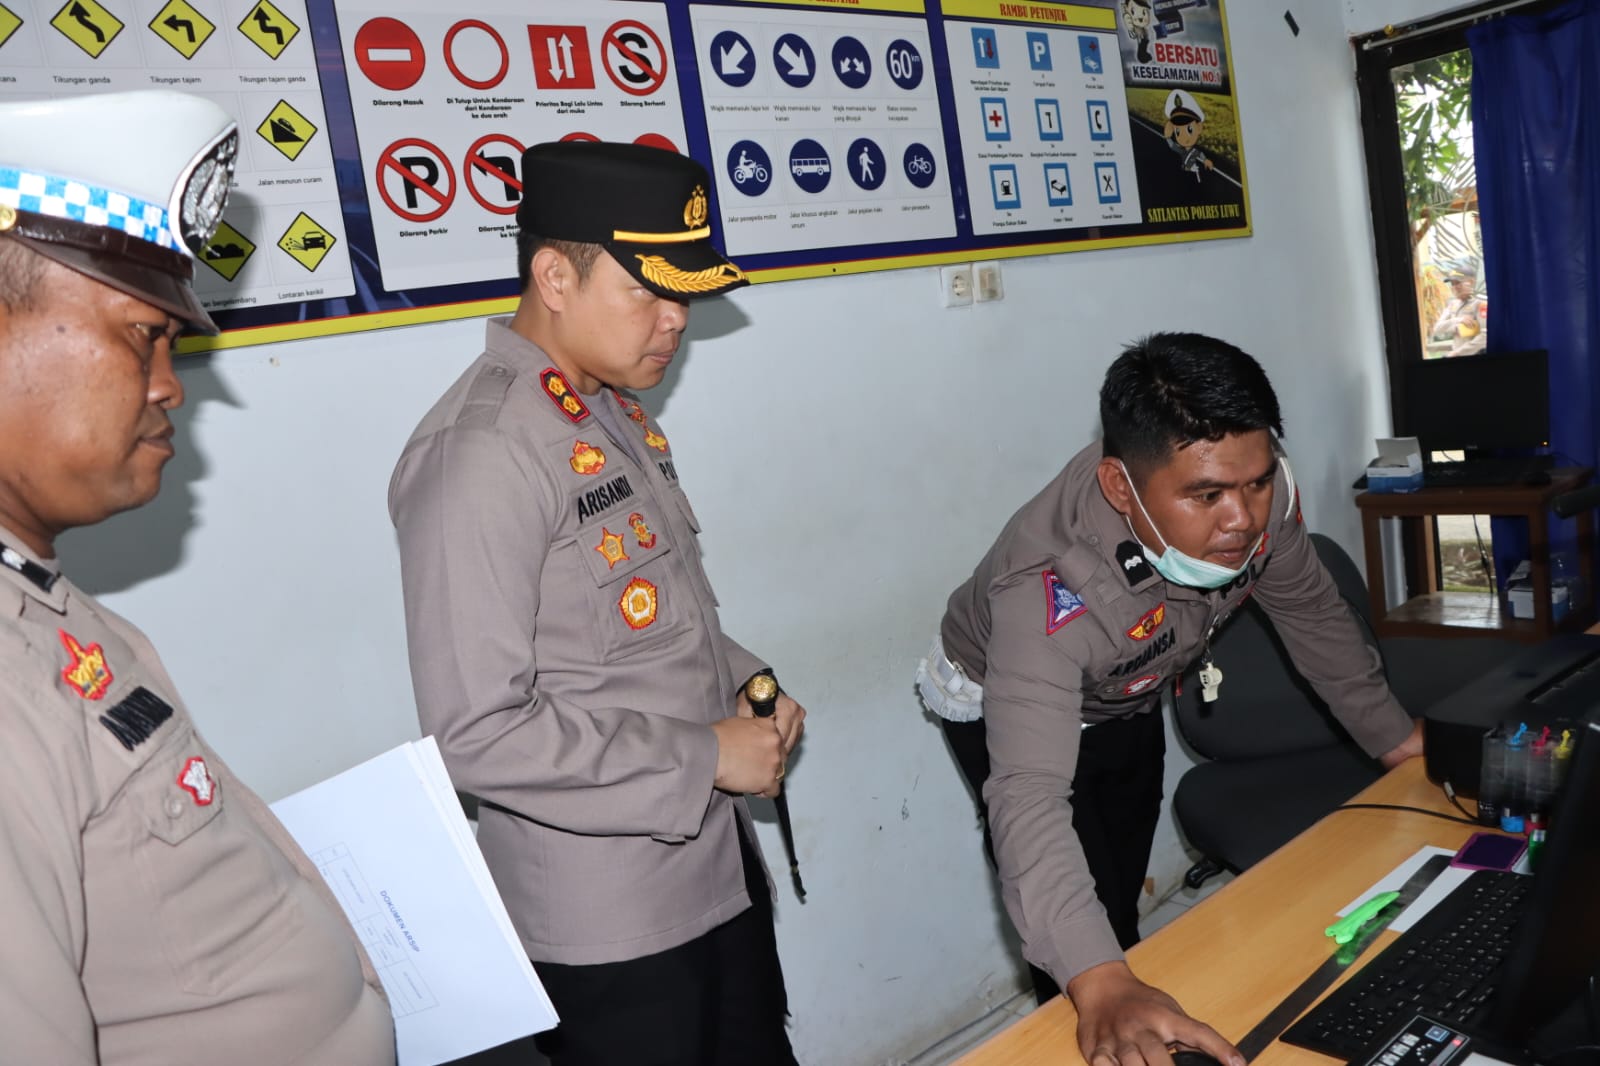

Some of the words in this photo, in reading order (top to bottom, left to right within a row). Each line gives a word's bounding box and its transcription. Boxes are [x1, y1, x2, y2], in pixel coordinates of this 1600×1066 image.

[999, 3, 1027, 17] RAMBU
[1030, 6, 1068, 22] PETUNJUK
[890, 49, 912, 79] 60
[1155, 43, 1218, 67] BERSATU
[88, 76, 111, 85] ganda
[1132, 66, 1200, 81] KESELAMATAN
[372, 99, 402, 107] Dilarang
[1147, 206, 1190, 223] SATLANTAS
[1190, 205, 1220, 220] POLRES
[429, 227, 448, 235] Parkir
[577, 474, 634, 524] ARISANDI
[379, 890, 406, 930] DOKUMEN
